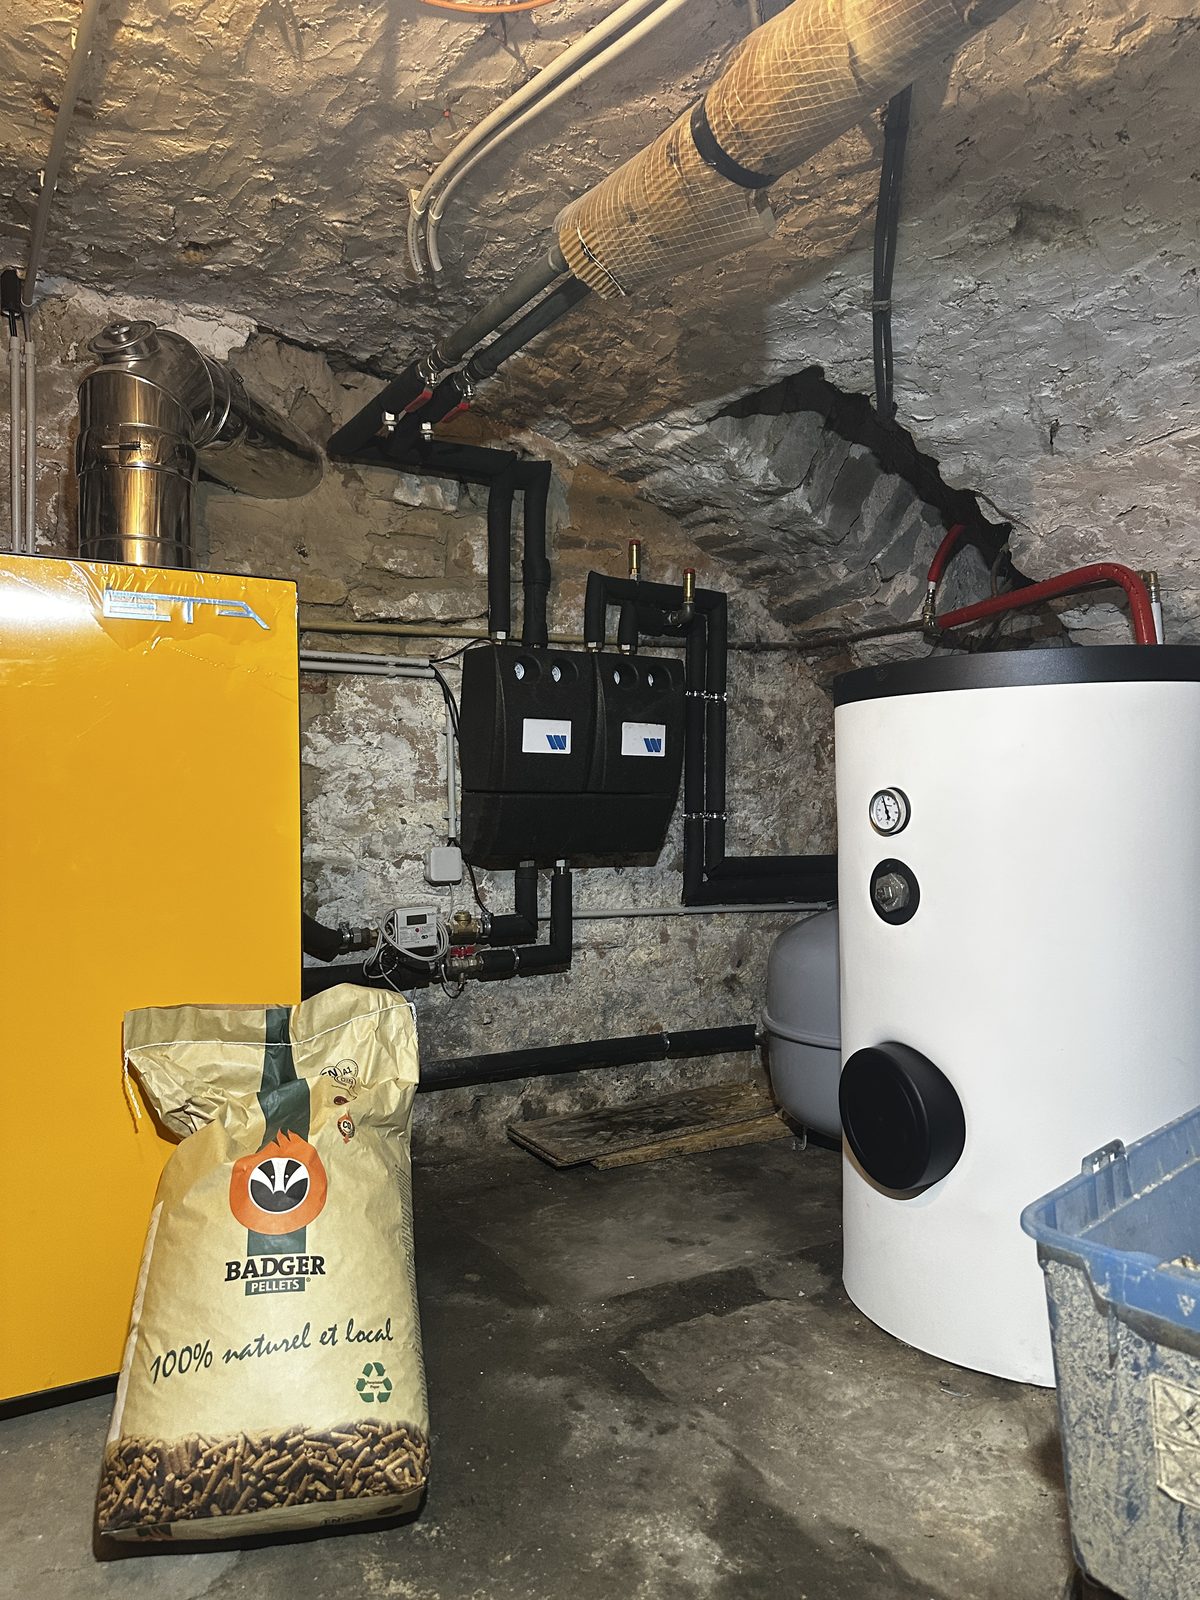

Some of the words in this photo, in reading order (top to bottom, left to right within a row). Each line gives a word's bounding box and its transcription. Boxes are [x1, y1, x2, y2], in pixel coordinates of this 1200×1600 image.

[224, 1255, 326, 1281] BADGER
[251, 1279, 300, 1293] PELLETS
[150, 1339, 213, 1384] 100%
[222, 1322, 312, 1364] naturel
[319, 1323, 338, 1346] et
[345, 1317, 394, 1343] local
